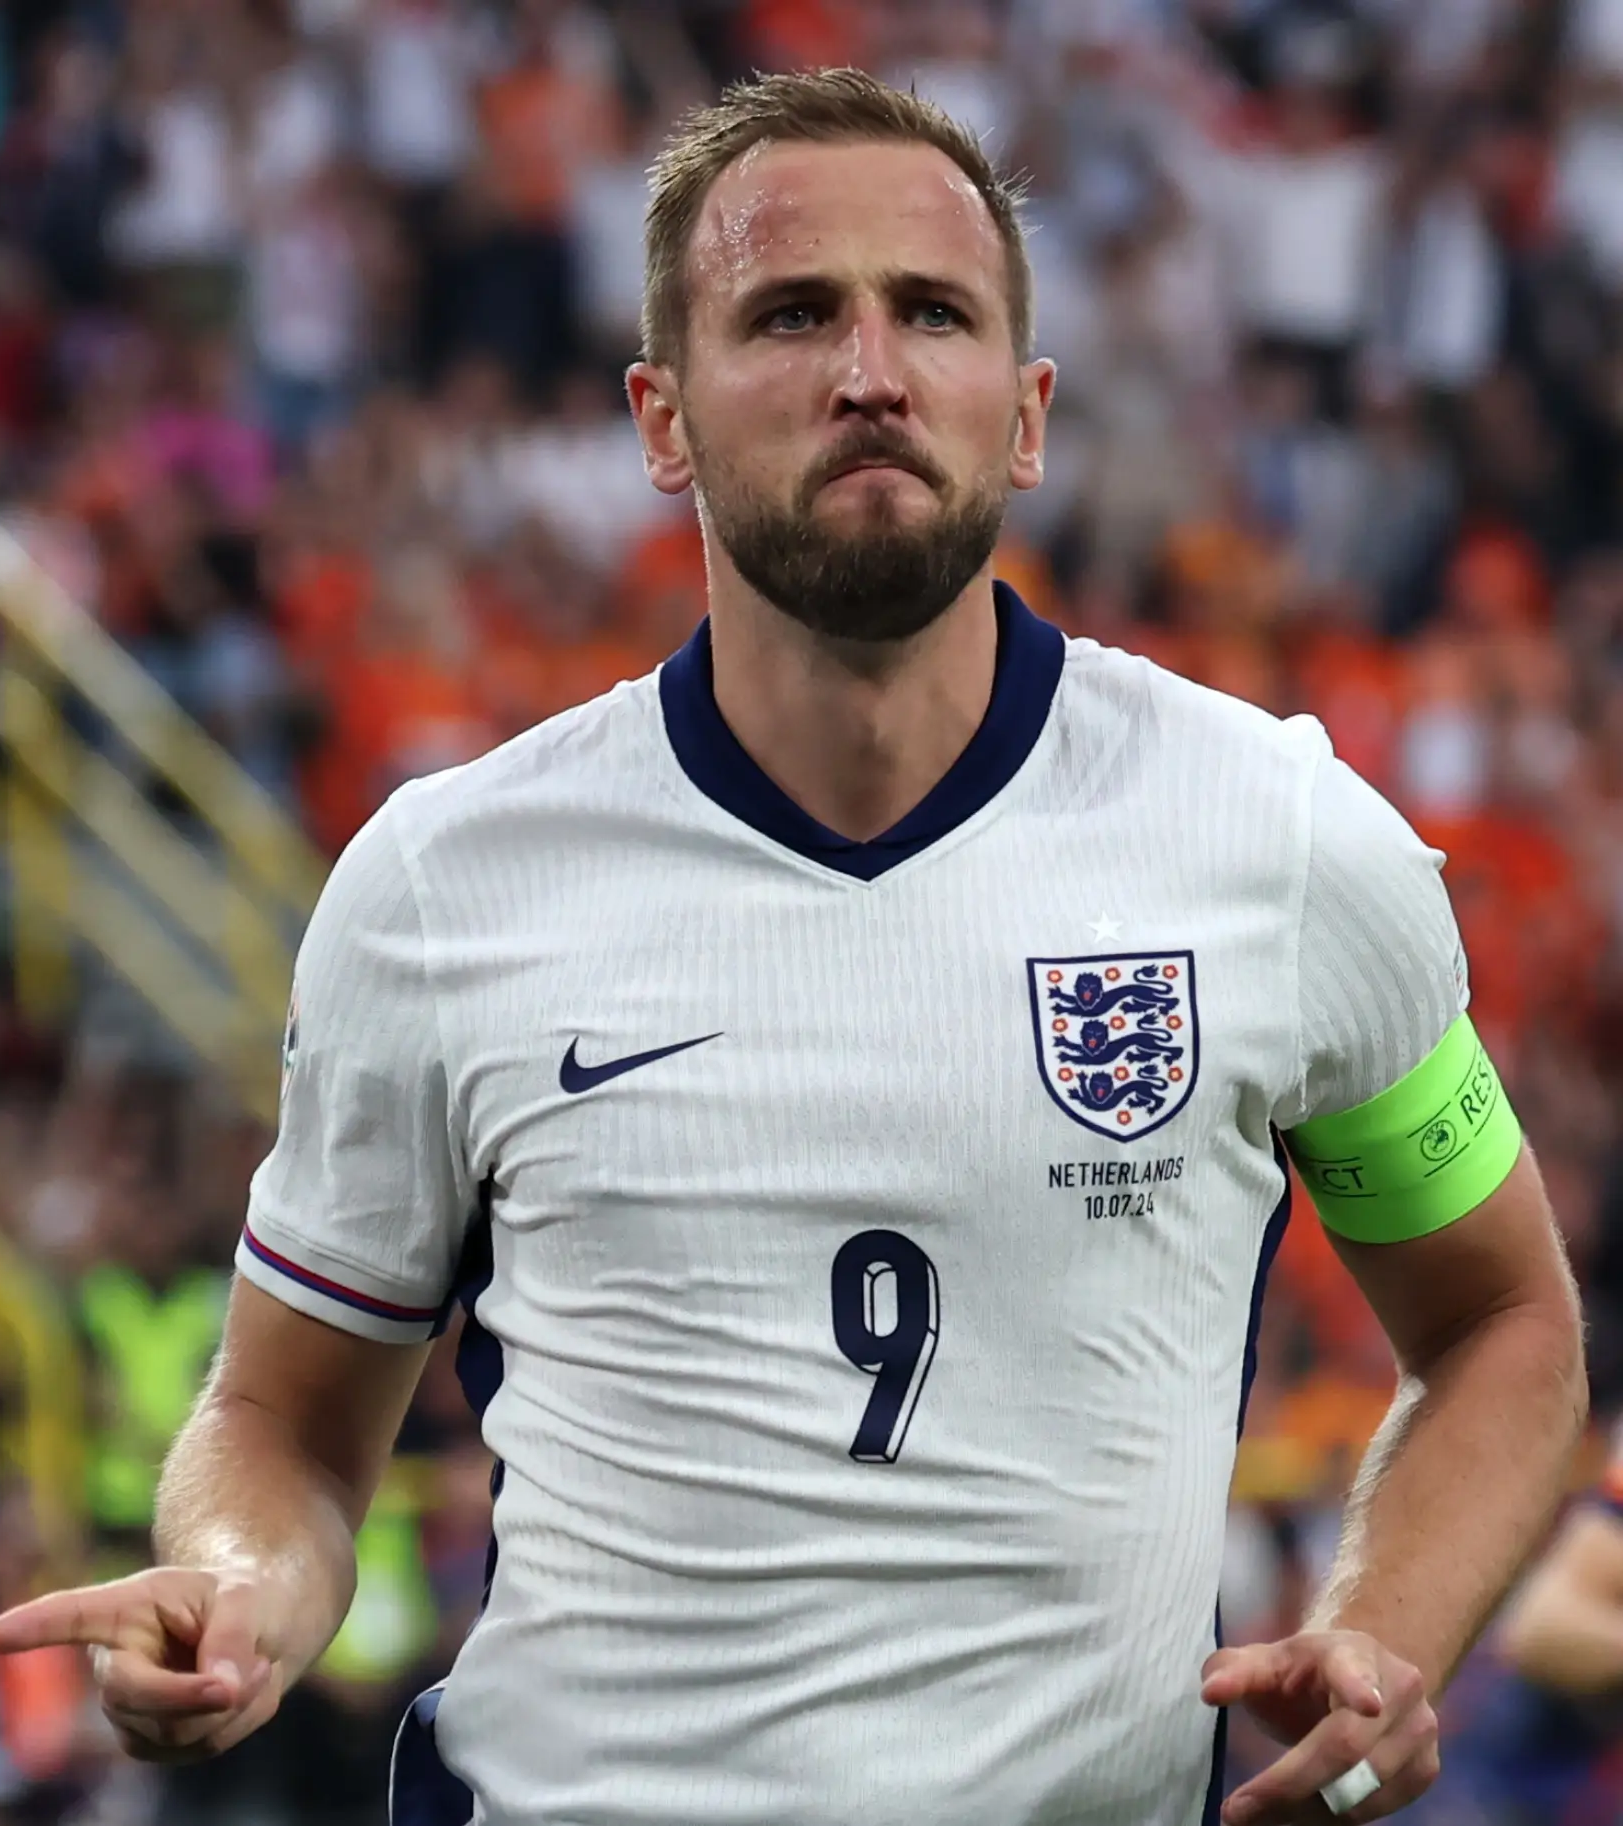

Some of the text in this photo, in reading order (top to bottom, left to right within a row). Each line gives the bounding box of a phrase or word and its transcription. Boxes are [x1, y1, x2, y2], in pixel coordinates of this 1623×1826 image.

[1049, 1156, 1184, 1188] NETHERLANDS
[1322, 1166, 1364, 1190] CT
[1084, 1192, 1154, 1220] 10.07.24
[831, 1229, 940, 1464] 9
